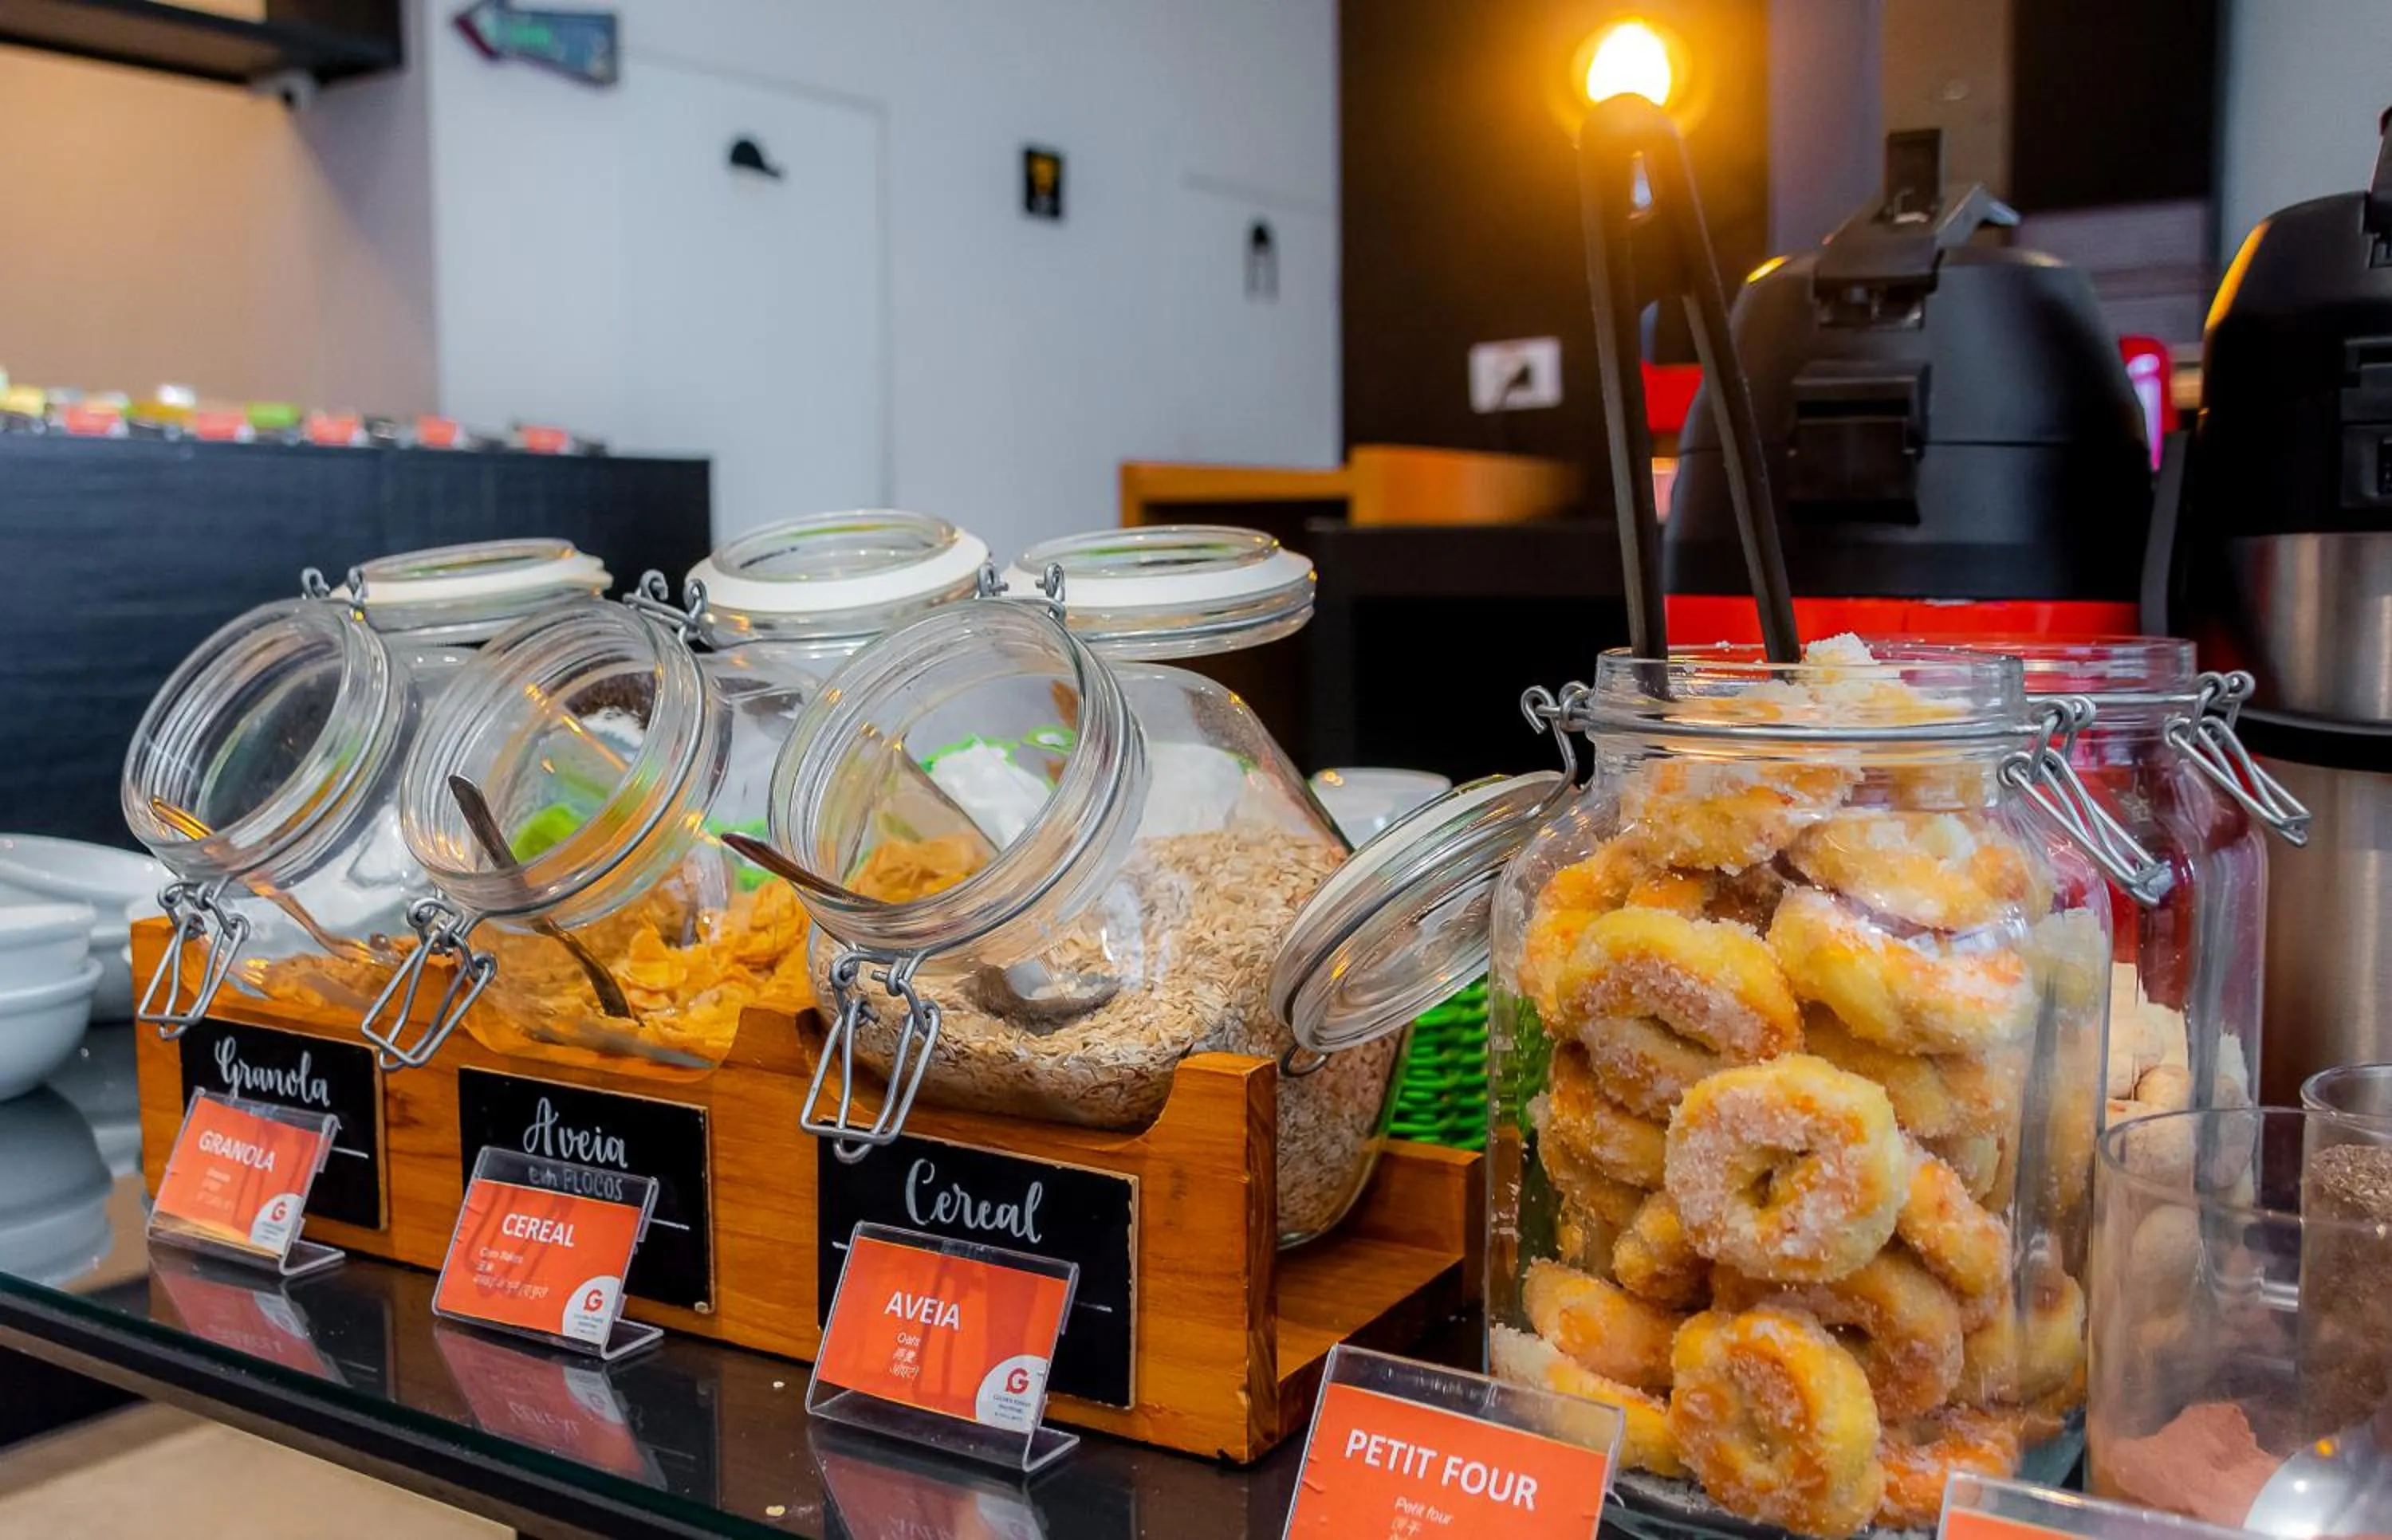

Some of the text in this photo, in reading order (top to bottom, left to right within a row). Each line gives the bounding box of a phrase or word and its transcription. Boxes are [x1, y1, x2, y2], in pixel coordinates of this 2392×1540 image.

[214, 1035, 331, 1107] Granola
[199, 1129, 275, 1173] GRANOLA
[523, 1097, 628, 1169] Aveia
[564, 1169, 623, 1202] FLOCOS
[906, 1158, 1042, 1243] Cereal
[502, 1212, 575, 1248] CEREAL
[884, 1291, 961, 1331] AVEIA
[1344, 1428, 1538, 1511] PETIT FOUR
